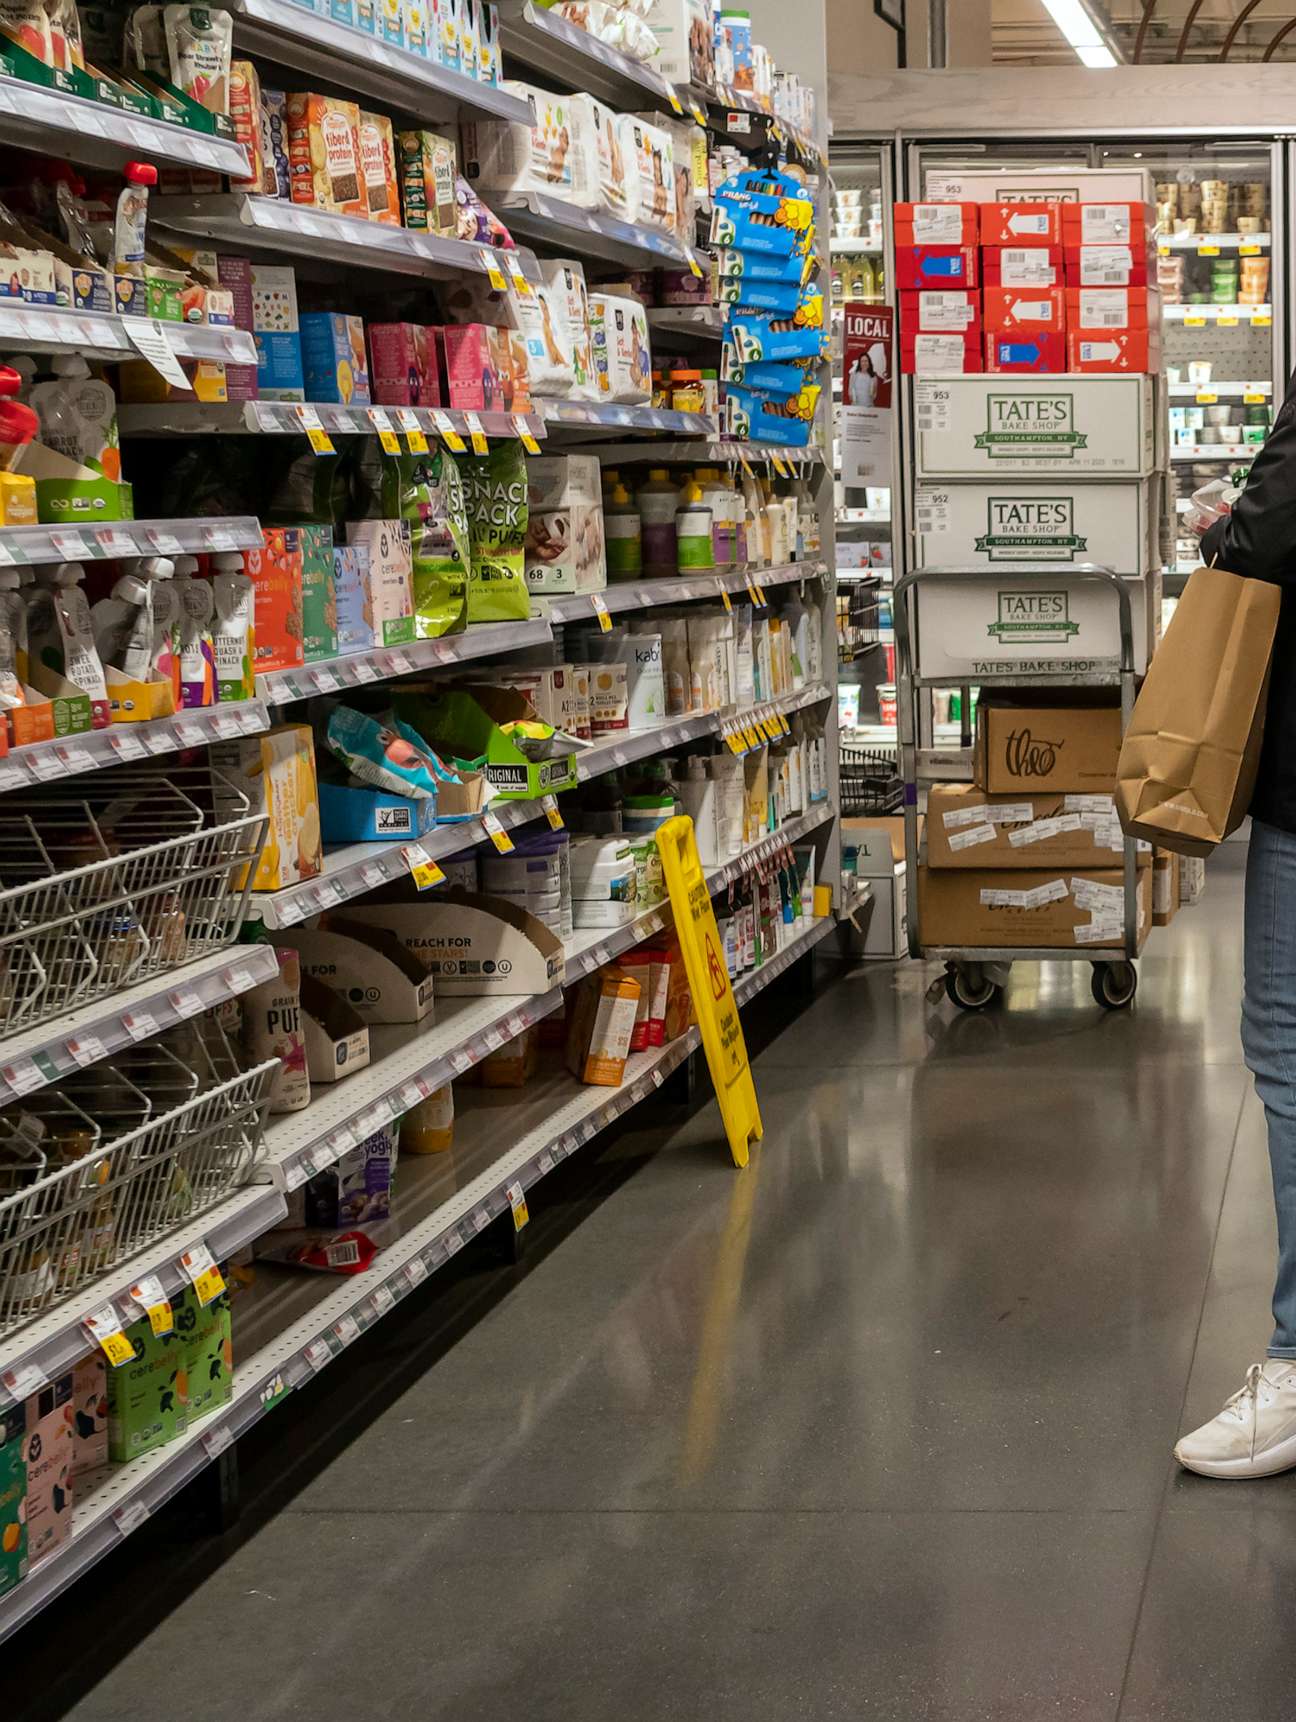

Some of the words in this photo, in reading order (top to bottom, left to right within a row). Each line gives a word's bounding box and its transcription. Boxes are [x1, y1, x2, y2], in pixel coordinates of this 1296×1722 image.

[945, 184, 962, 194] 953
[847, 317, 890, 337] LOCAL
[933, 391, 949, 400] 953
[994, 400, 1067, 421] TATE'S
[1002, 421, 1029, 430] BAKE
[1032, 421, 1058, 430] SHOP
[932, 495, 949, 504] 952
[464, 503, 518, 526] PACK
[994, 504, 1067, 524] TATE'S
[1002, 525, 1029, 533] BAKE
[1033, 525, 1058, 533] SHOP
[529, 570, 543, 579] 68
[556, 569, 562, 579] 3
[1003, 596, 1063, 613] TATE'S
[1019, 661, 1056, 672] BAKE
[1061, 660, 1096, 672] SHOP
[1004, 727, 1065, 777] theo
[488, 768, 522, 783] RIGINAL
[406, 938, 445, 949] REACH
[448, 937, 471, 948] FOR
[312, 965, 337, 975] FOR
